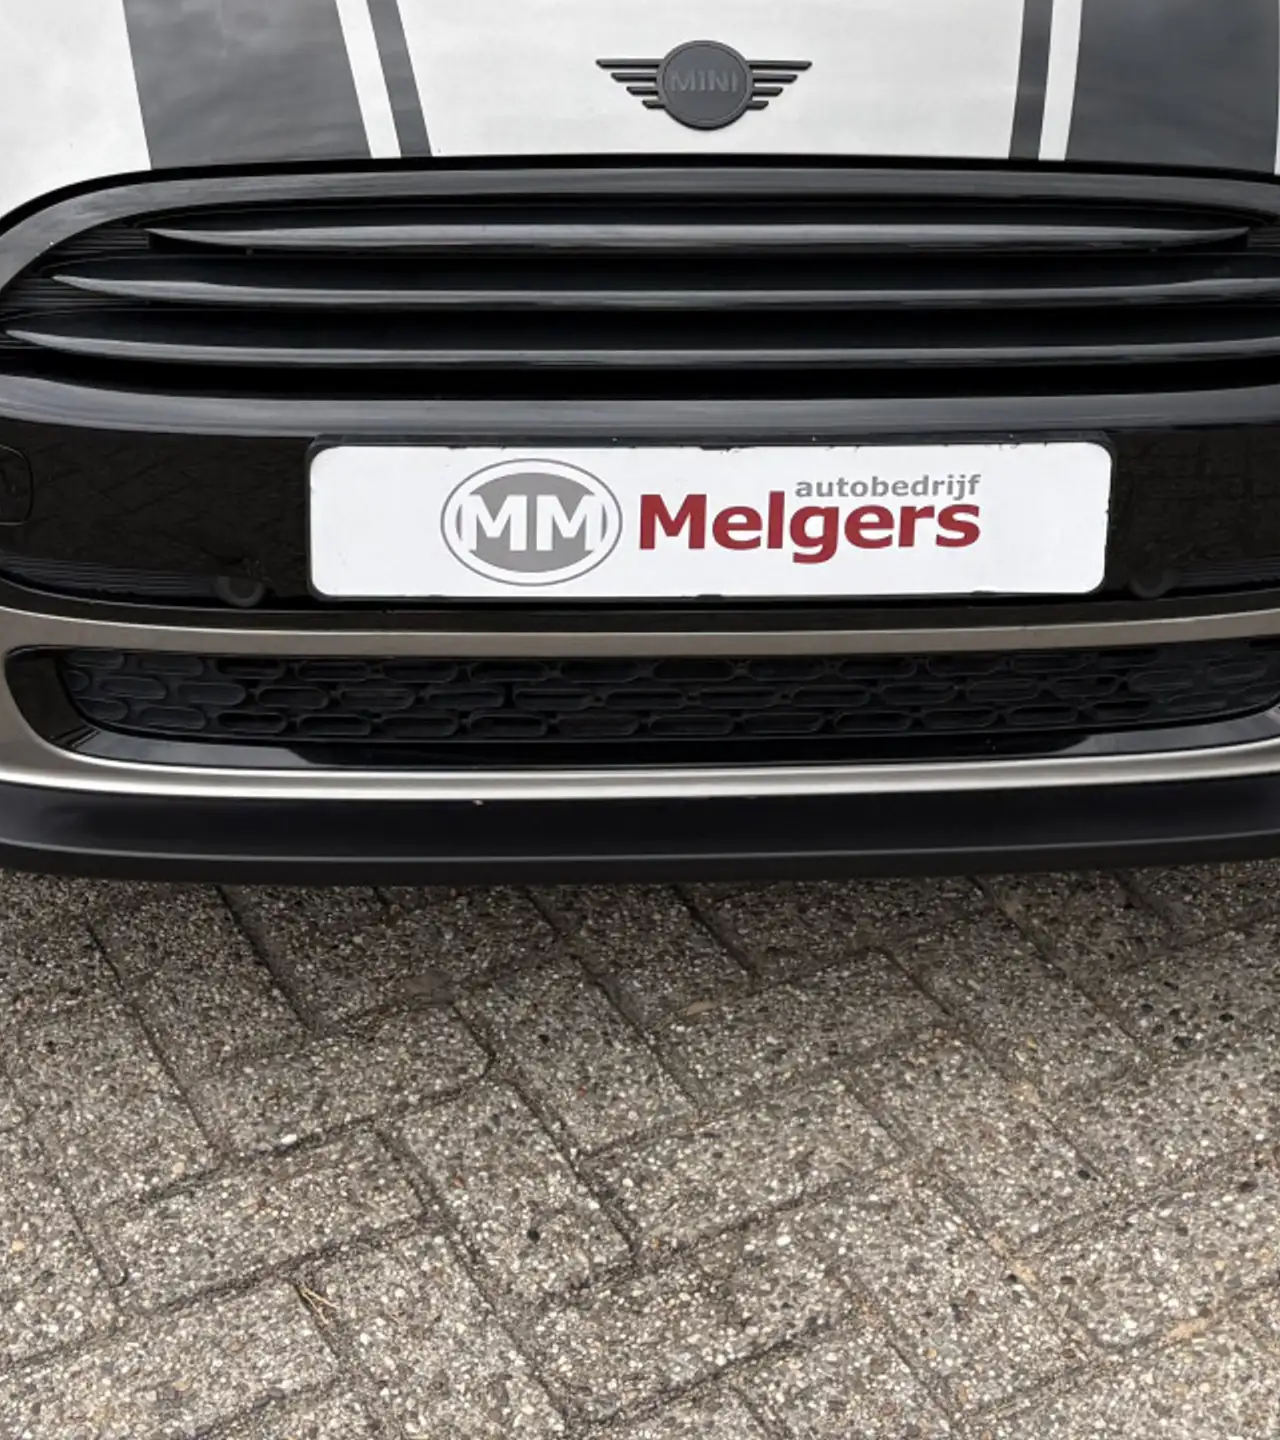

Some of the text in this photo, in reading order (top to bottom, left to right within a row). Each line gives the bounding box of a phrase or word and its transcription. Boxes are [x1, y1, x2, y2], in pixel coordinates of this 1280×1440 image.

[671, 70, 737, 91] MINI
[795, 475, 981, 501] autobedrijf
[461, 490, 981, 564] MM Melgers
